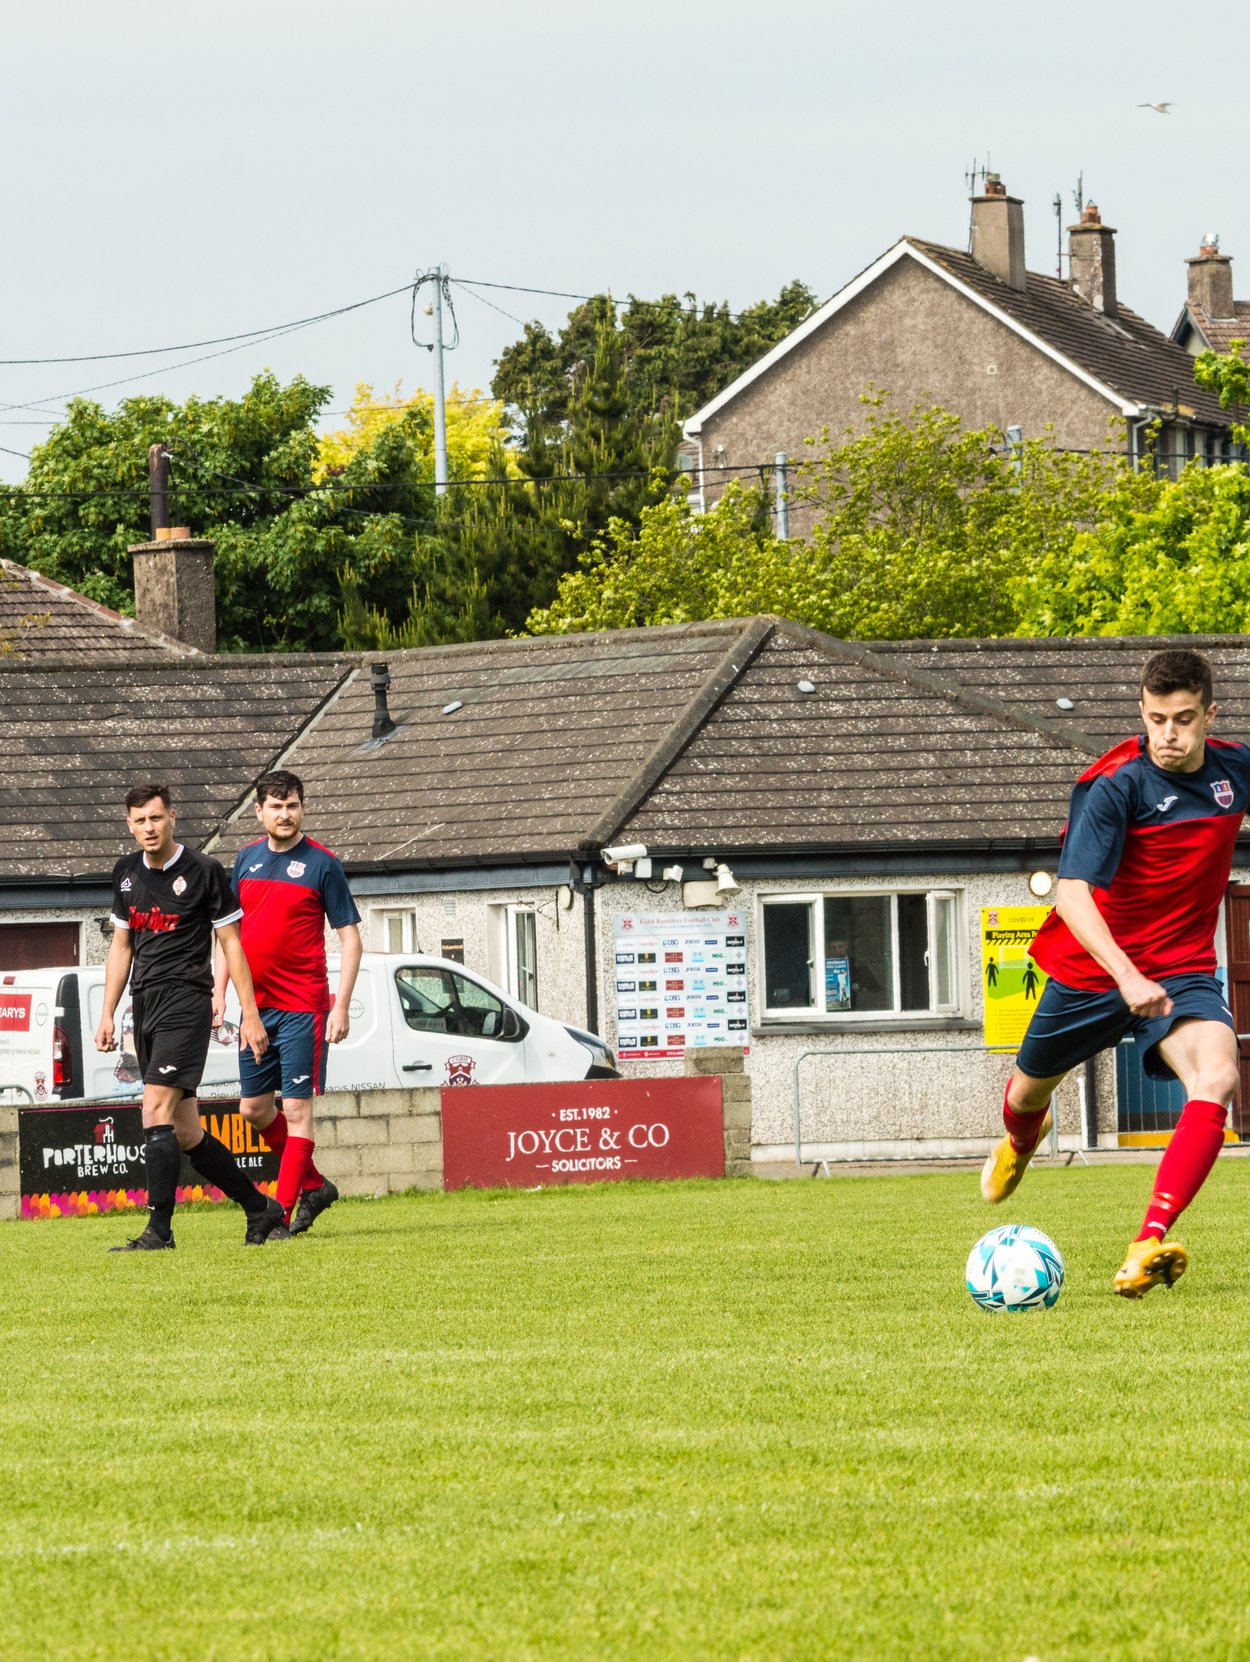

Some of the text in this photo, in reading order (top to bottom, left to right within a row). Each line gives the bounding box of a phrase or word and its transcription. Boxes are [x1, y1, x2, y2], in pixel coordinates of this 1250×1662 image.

[1016, 930, 1031, 938] Area
[0, 1007, 26, 1019] ARYS
[351, 1081, 386, 1090] NISSAN
[505, 1123, 670, 1161] JOYCE & CO
[42, 1143, 147, 1169] PORTERHOUS
[235, 1156, 263, 1168] LE ALE
[77, 1162, 129, 1178] BREW CO.
[551, 1156, 622, 1173] SOLICITORS
